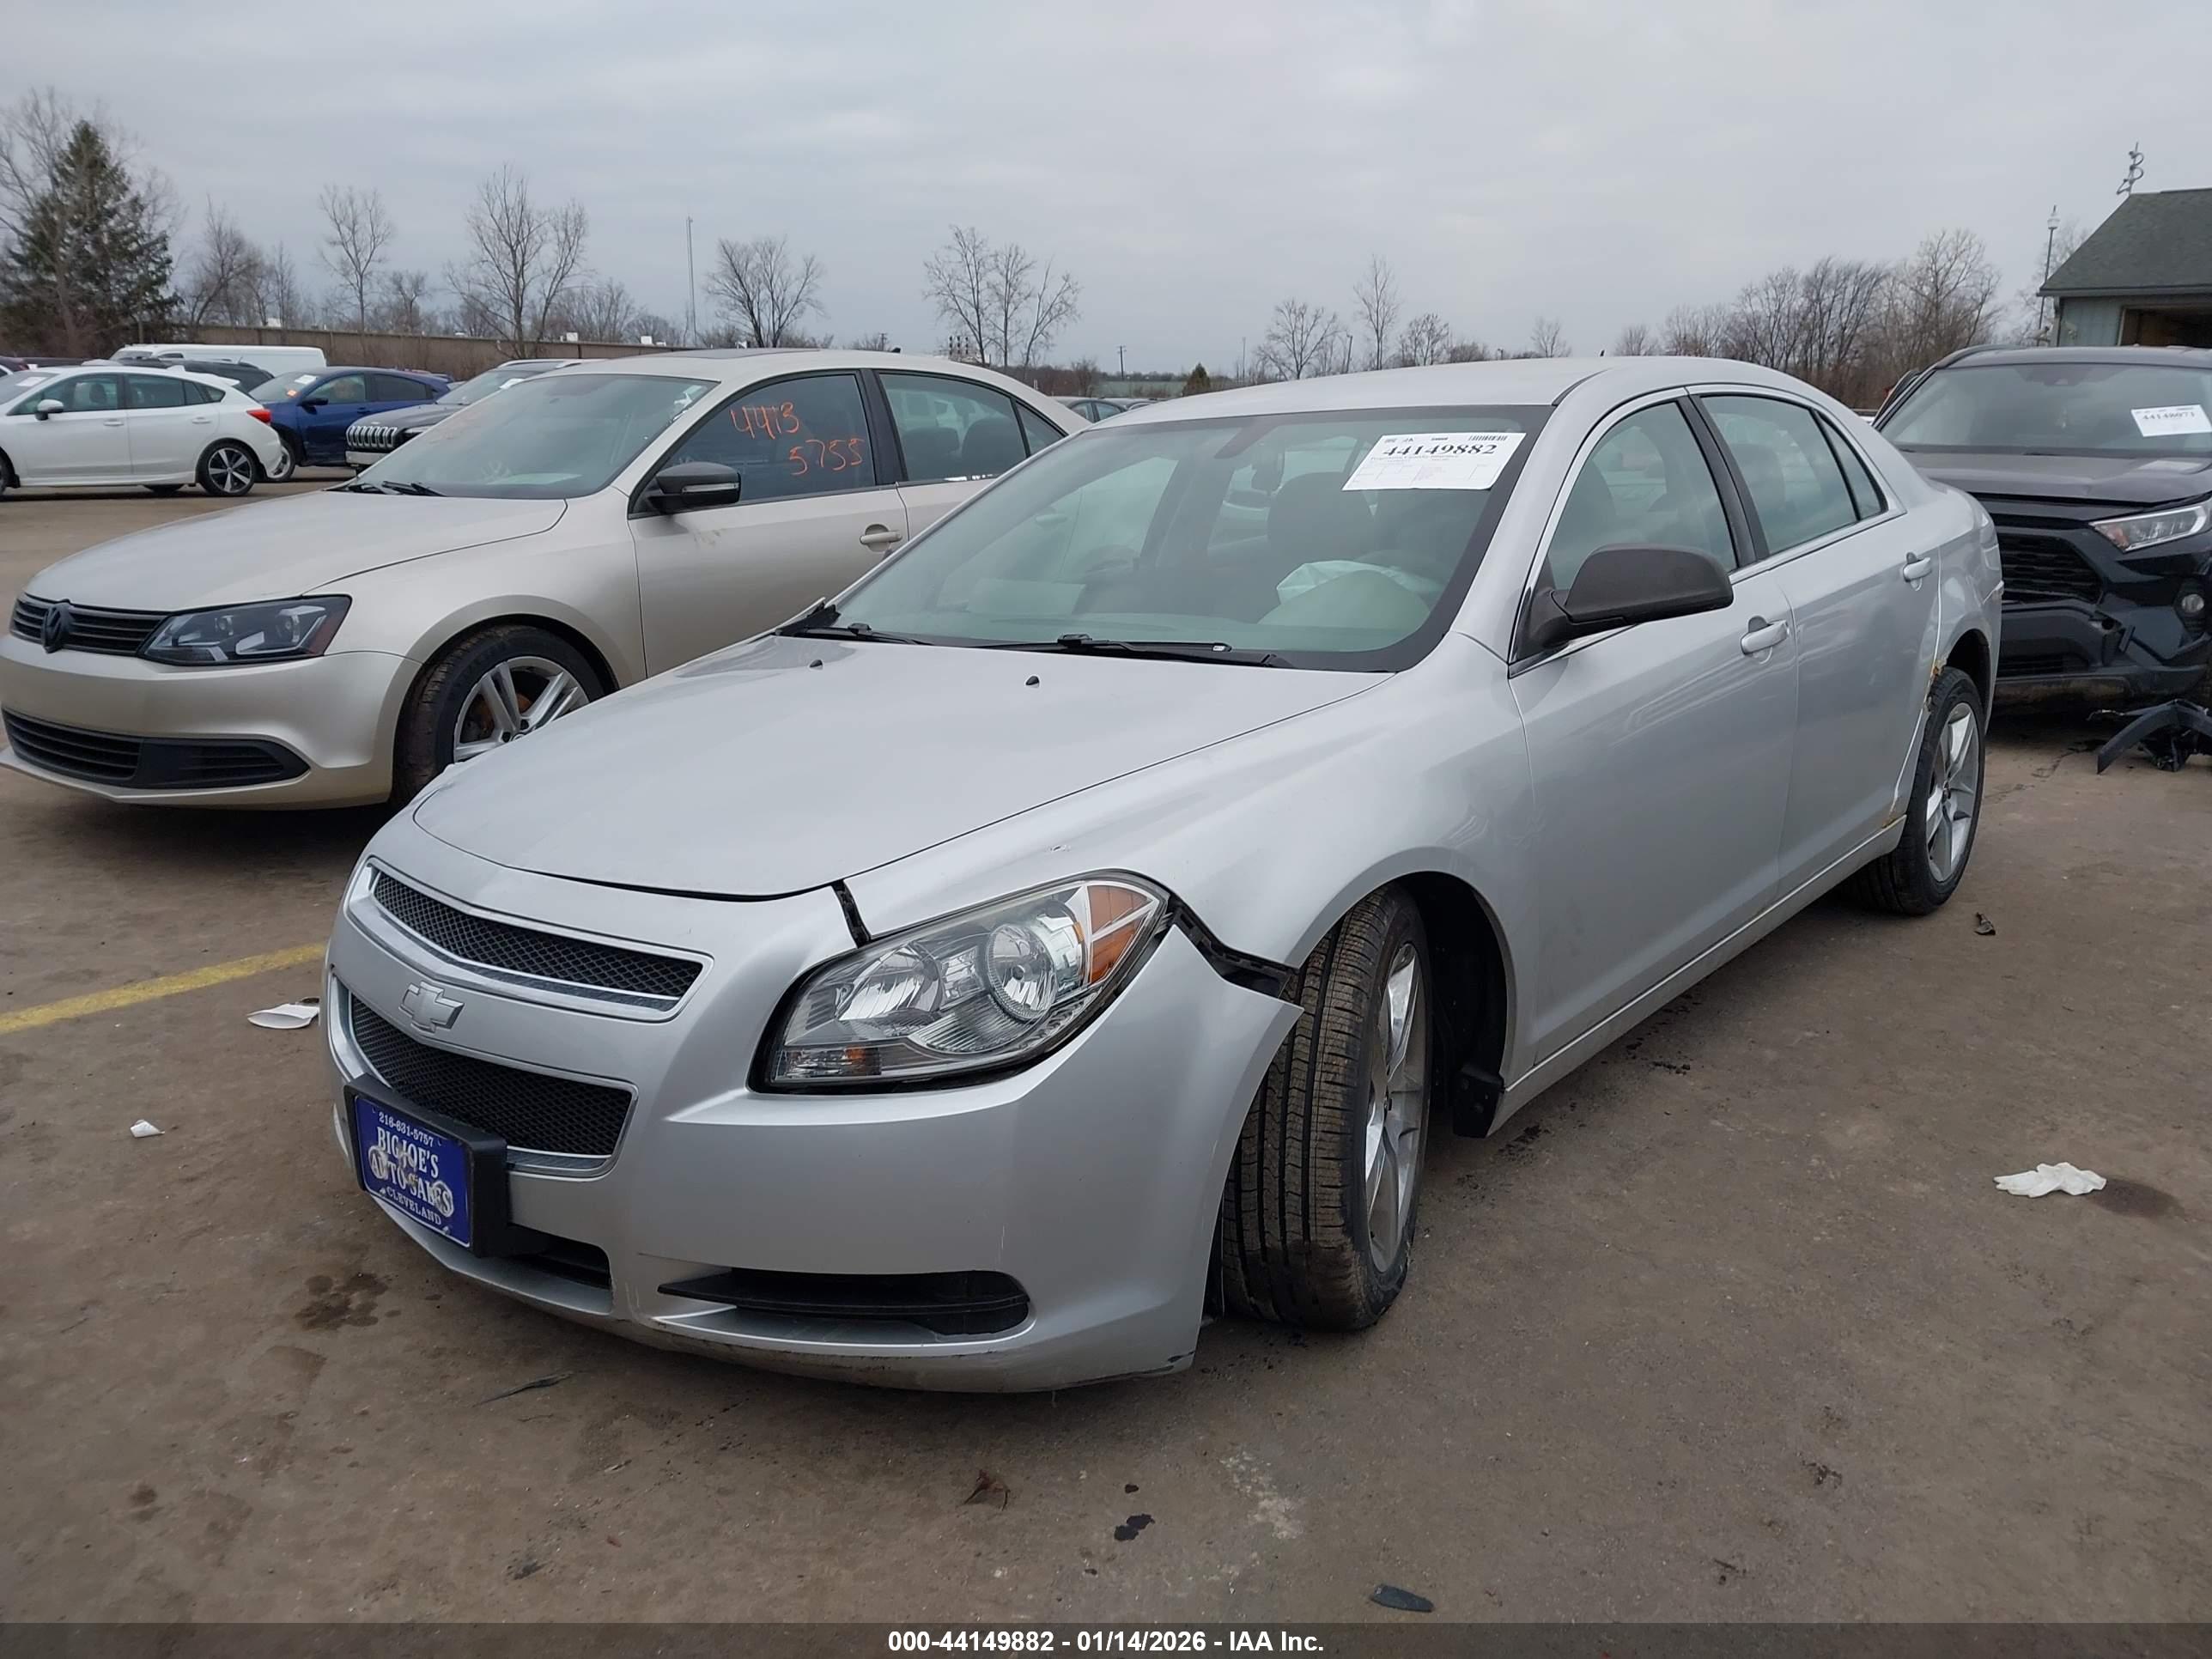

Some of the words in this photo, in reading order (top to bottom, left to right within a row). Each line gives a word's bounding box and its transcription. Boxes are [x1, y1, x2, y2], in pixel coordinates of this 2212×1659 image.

[788, 438, 865, 476] 5755
[1383, 444, 1498, 456] 44149882
[379, 1111, 434, 1148] 216-631-5757
[377, 1126, 400, 1159] BIG
[402, 1139, 439, 1179] JOE'S
[386, 1186, 442, 1225] CLEVELAND
